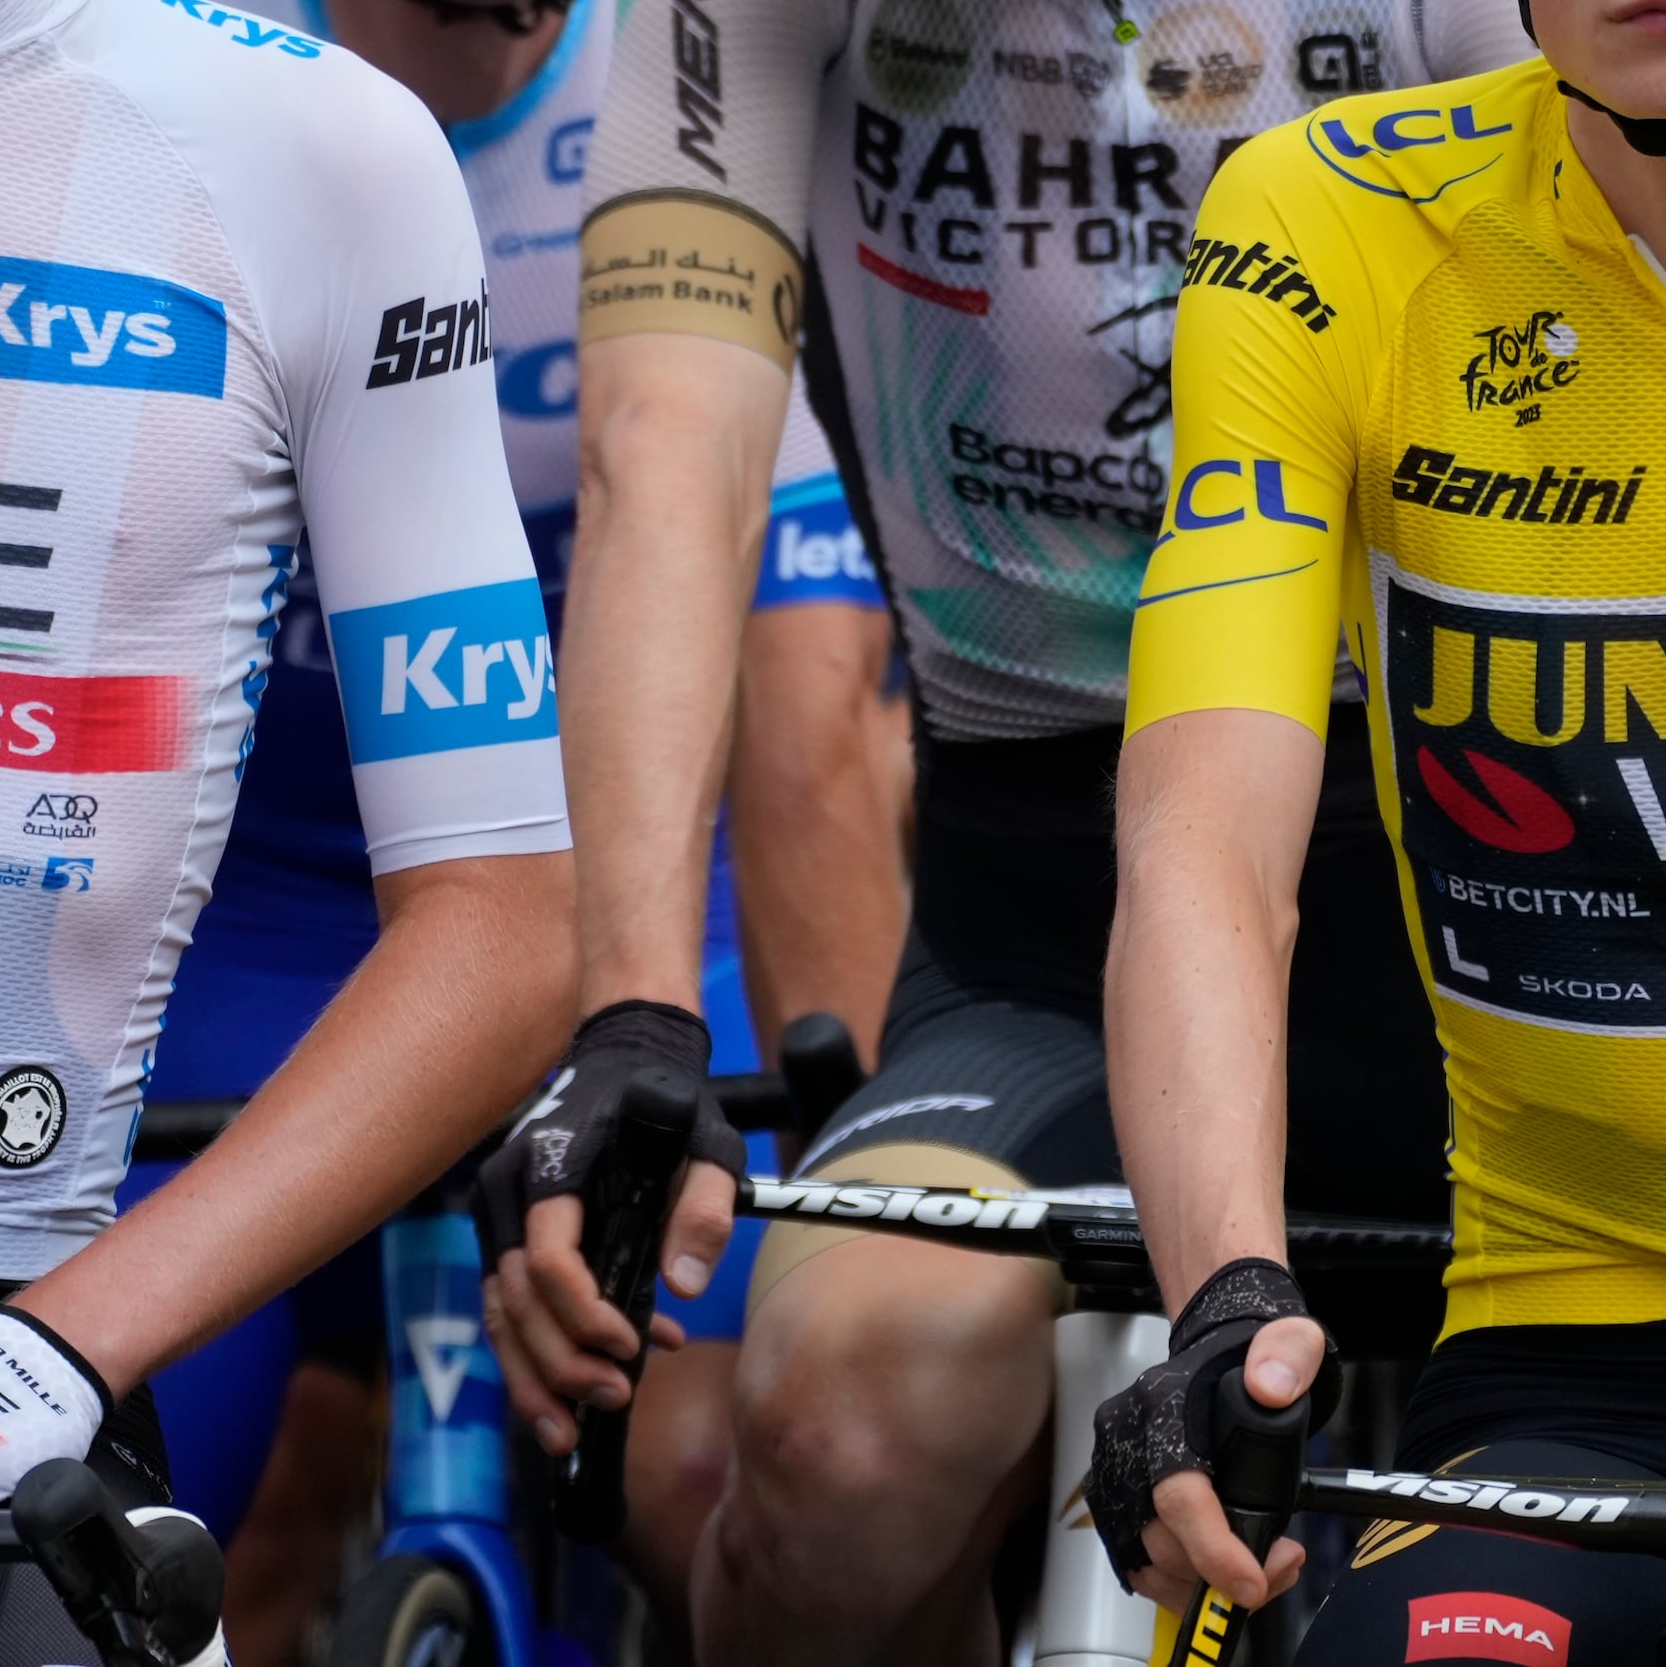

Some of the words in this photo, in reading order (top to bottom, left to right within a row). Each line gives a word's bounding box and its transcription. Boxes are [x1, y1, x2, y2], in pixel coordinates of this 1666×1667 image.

[854, 101, 1231, 216] BAHR
[1321, 105, 1514, 159] LCL
[854, 180, 1189, 271] VICTOR
[673, 280, 753, 315] Bank
[1180, 230, 1338, 334] antini
[366, 277, 493, 390] Sant
[948, 422, 1167, 501] Bapco
[1393, 445, 1648, 525] Santini
[1153, 460, 1329, 550] CL
[25, 793, 98, 825] ADQ
[1447, 873, 1651, 918] BETCITY.NL
[5, 1357, 68, 1416] MILLE
[1420, 1615, 1556, 1655] HEMA
